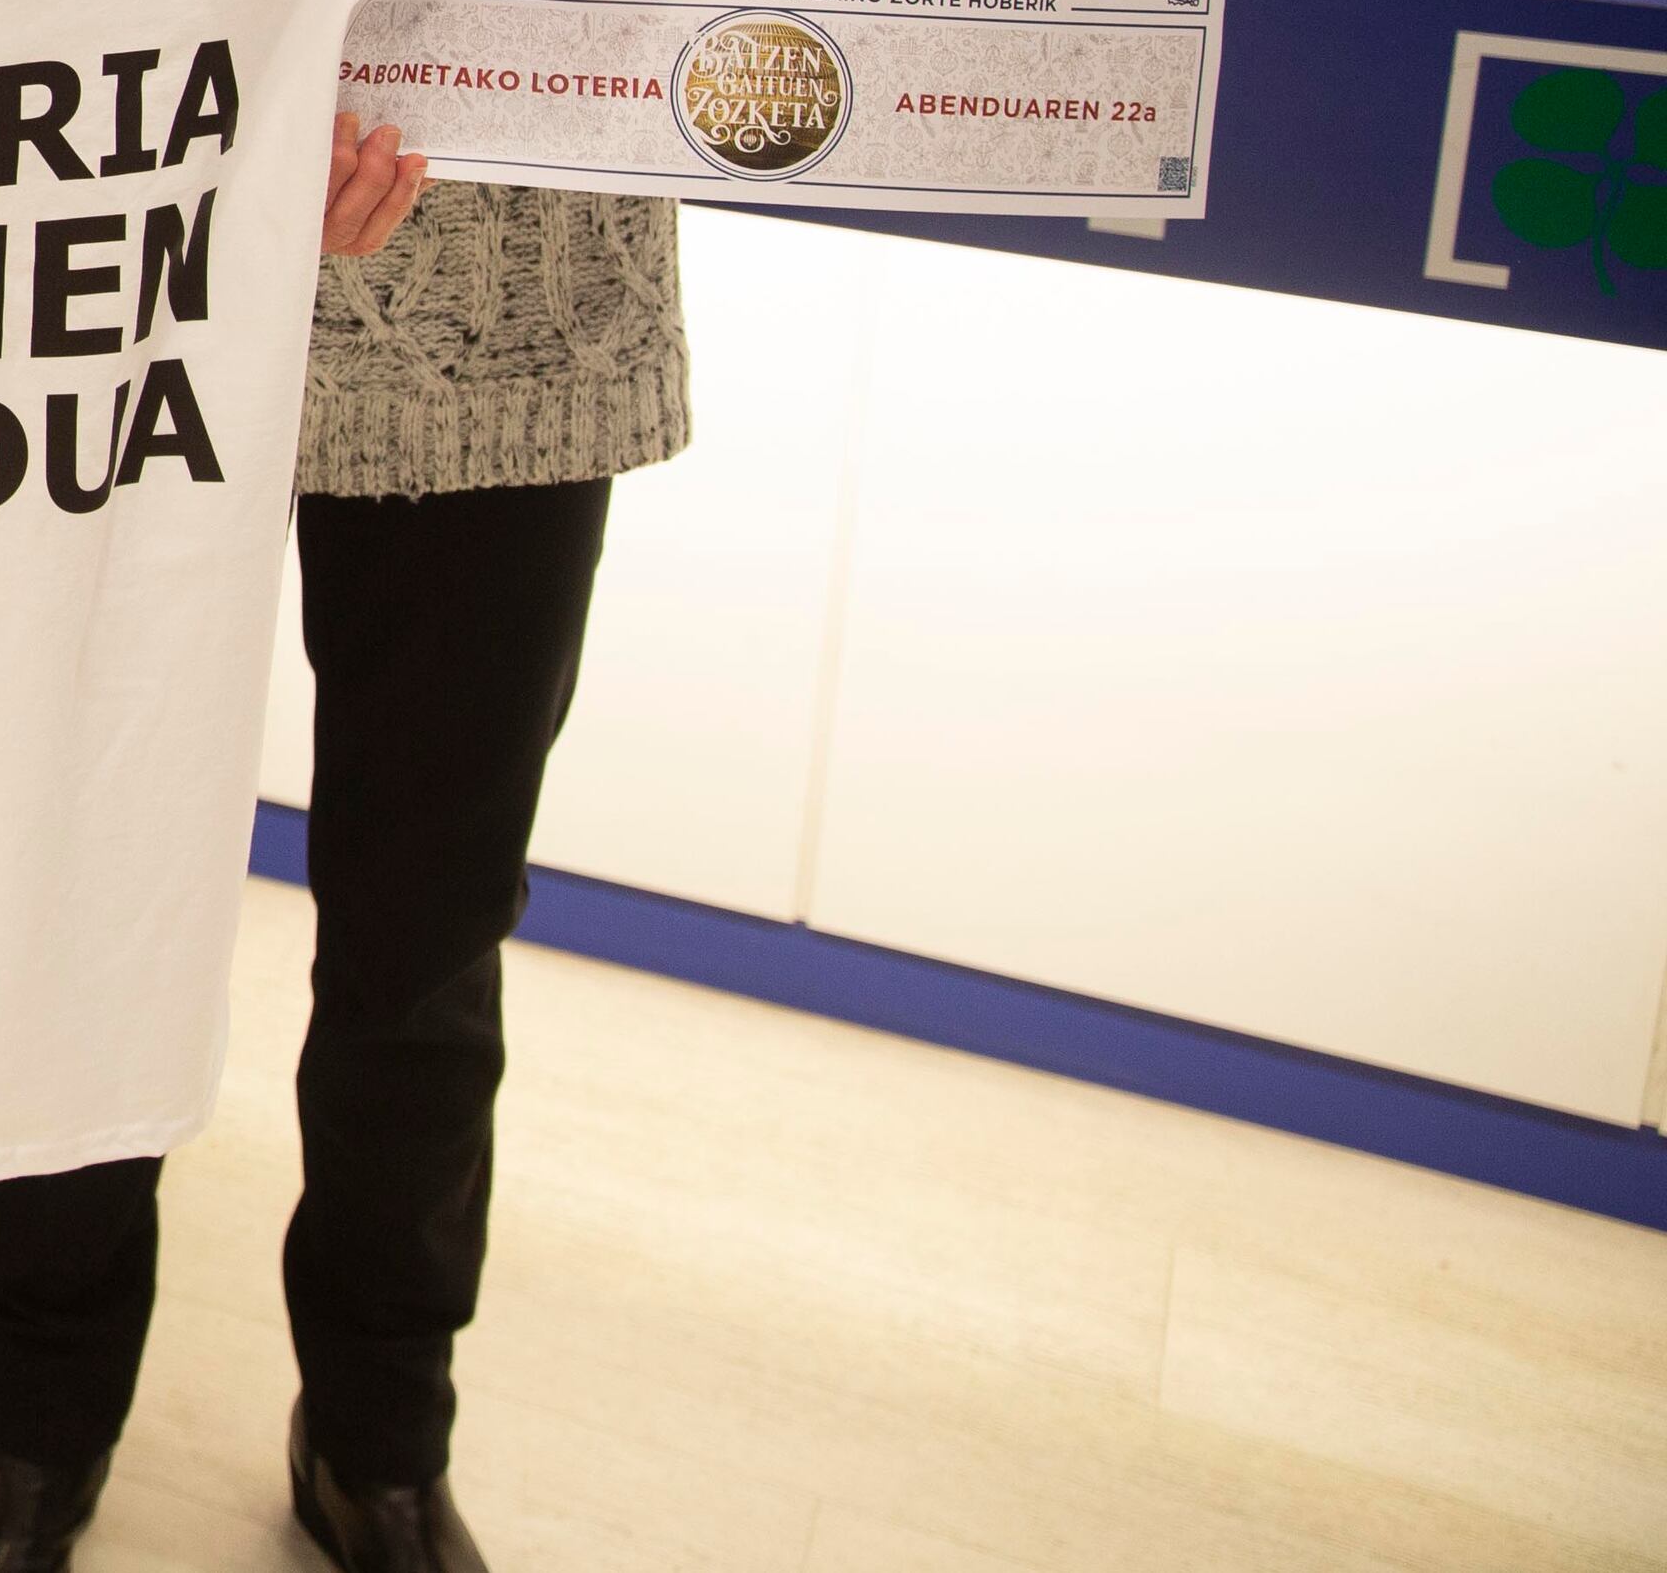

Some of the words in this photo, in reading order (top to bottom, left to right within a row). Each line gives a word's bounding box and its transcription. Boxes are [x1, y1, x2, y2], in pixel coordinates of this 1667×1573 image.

[691, 31, 822, 78] BATZEN
[338, 61, 521, 92] GABONETAKO
[530, 72, 664, 100] LOTERIA
[687, 87, 827, 145] ZOZKETA
[895, 93, 1100, 120] ABENDUAREN
[1110, 101, 1157, 122] 22a
